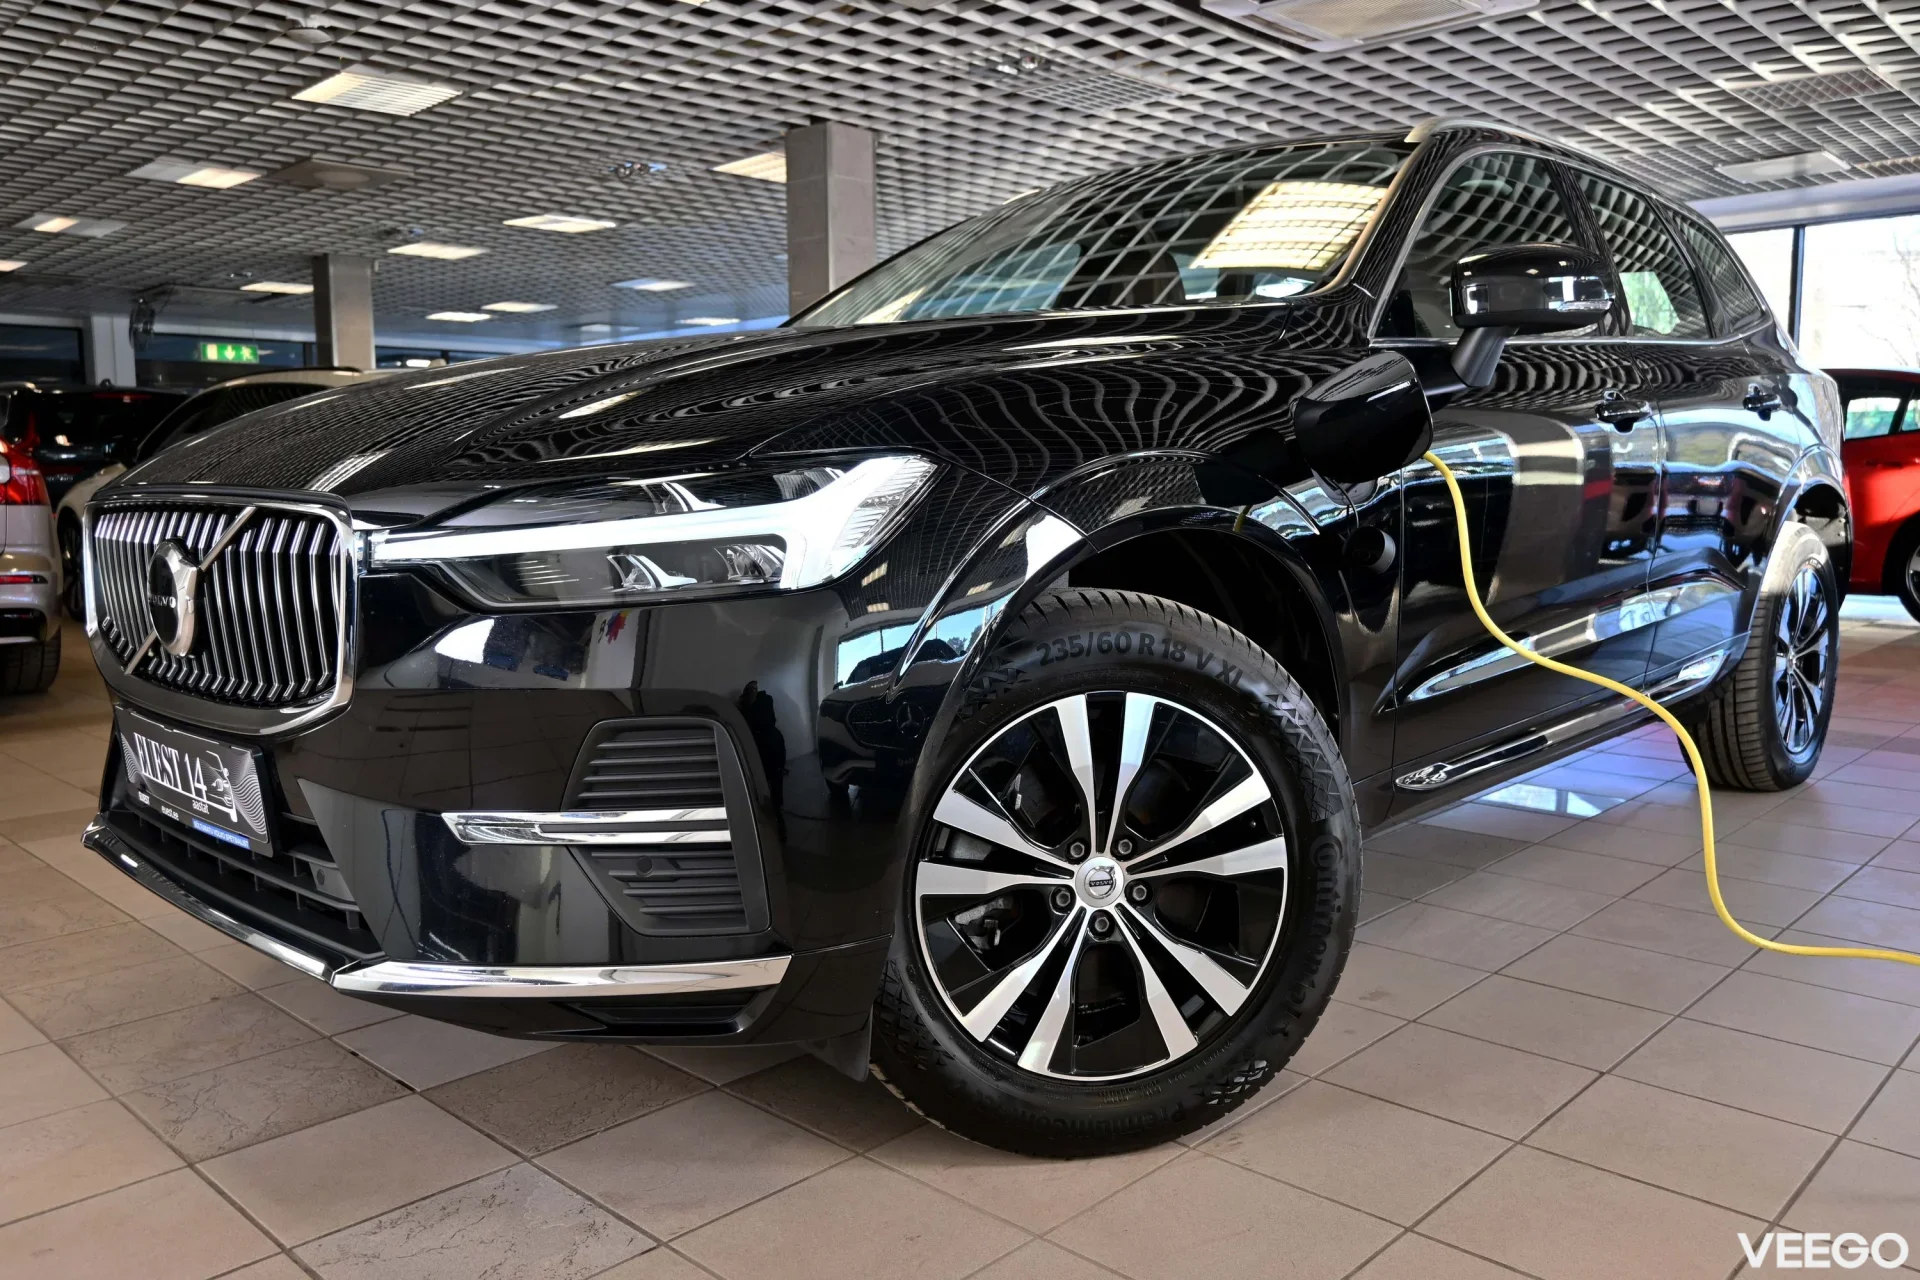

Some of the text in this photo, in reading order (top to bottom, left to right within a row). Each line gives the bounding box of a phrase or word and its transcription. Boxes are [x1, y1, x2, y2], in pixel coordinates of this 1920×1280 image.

[148, 595, 176, 608] OLVO
[1036, 631, 1243, 688] 235/60 R 18 V XL
[184, 753, 207, 801] 14
[1284, 835, 1342, 1019] Continental
